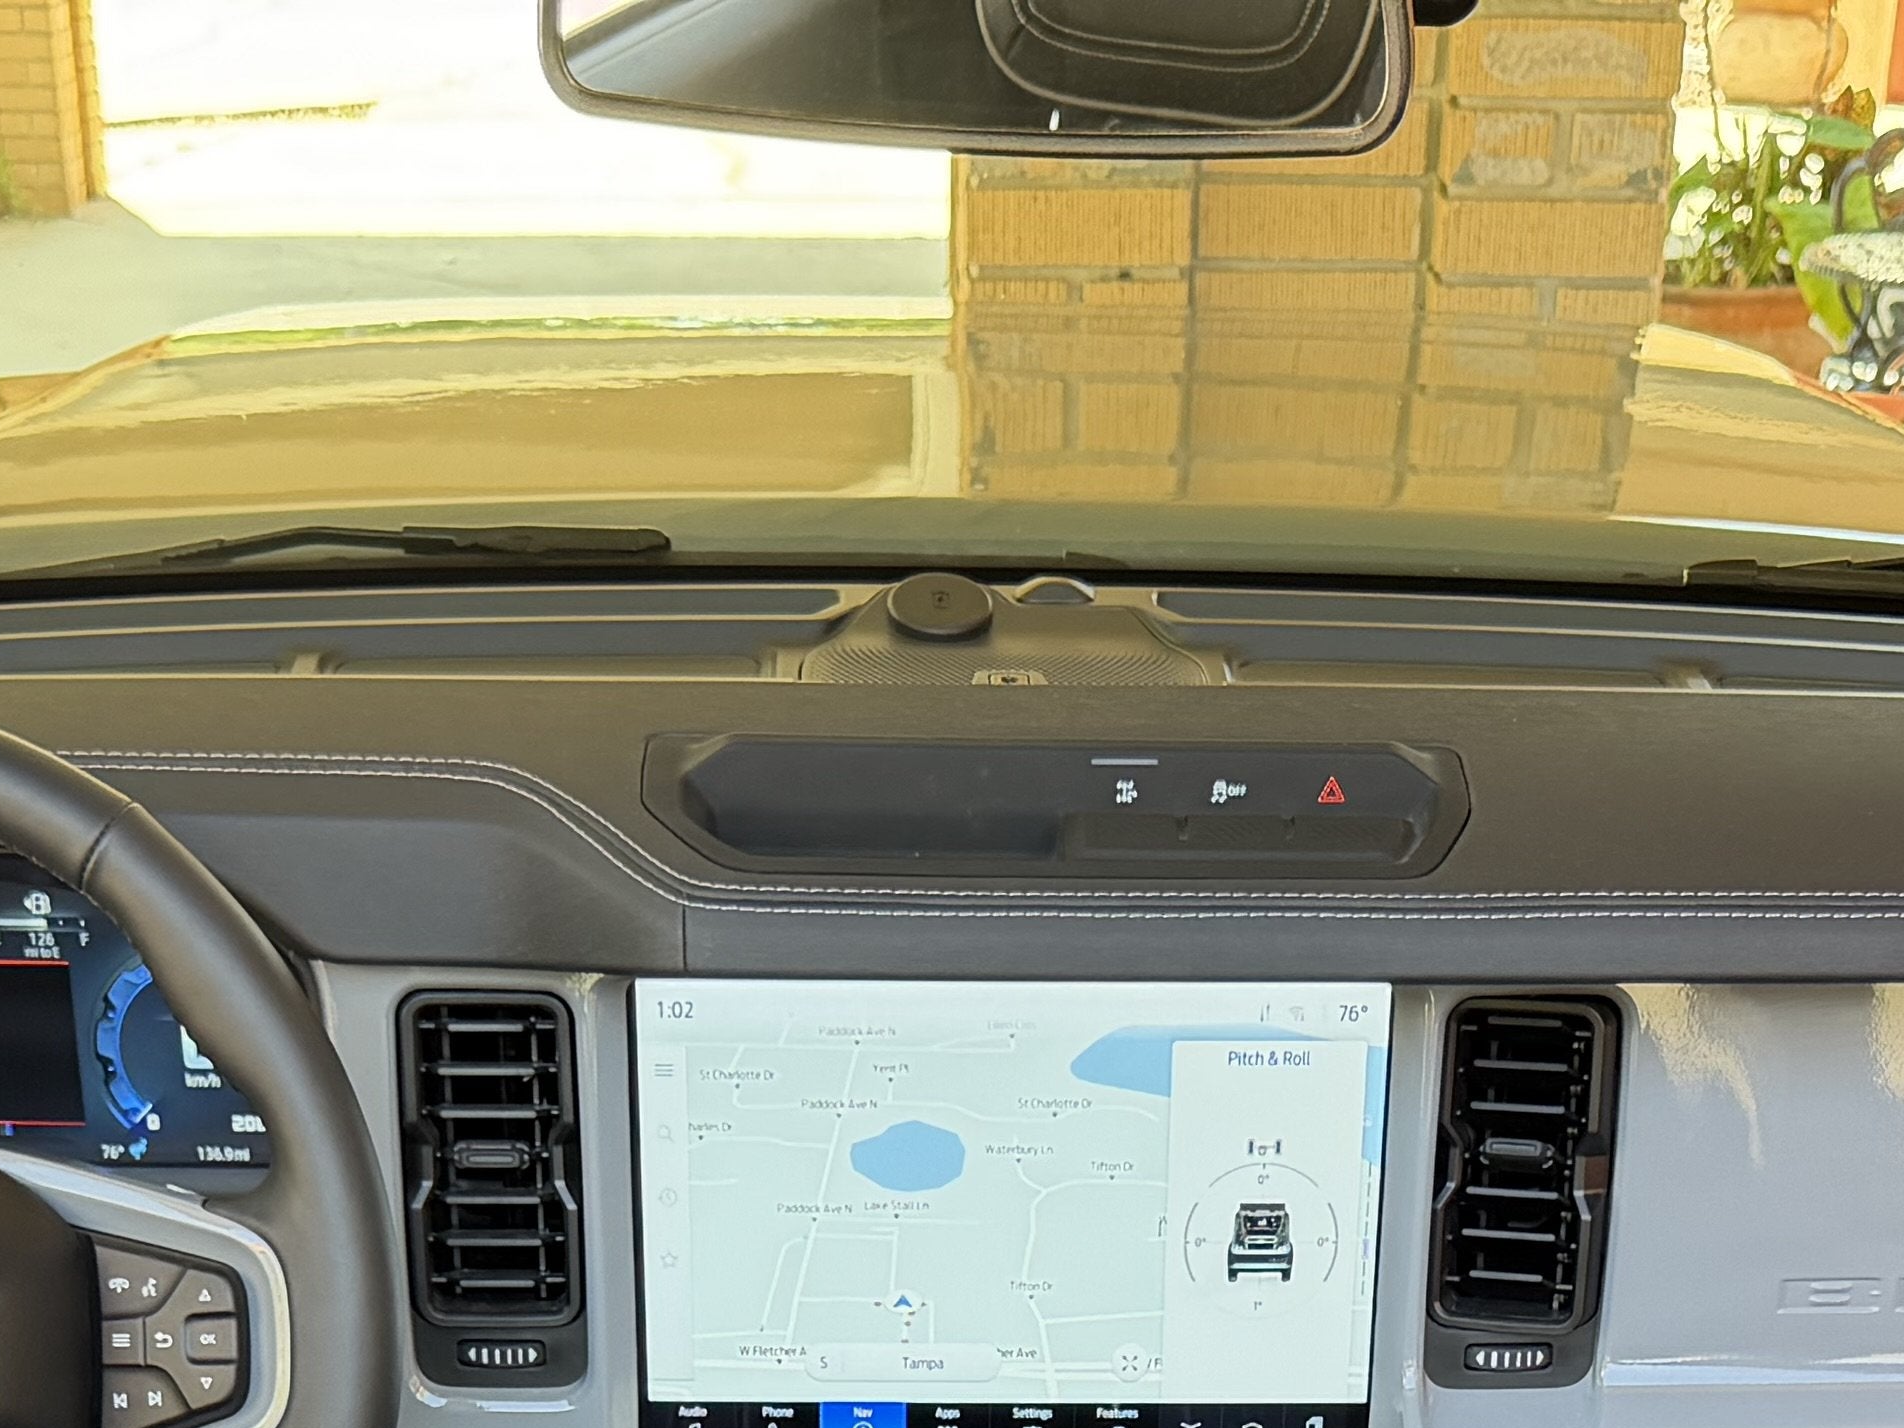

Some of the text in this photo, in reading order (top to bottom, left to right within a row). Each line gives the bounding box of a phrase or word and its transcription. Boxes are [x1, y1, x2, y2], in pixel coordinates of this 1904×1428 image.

[79, 932, 90, 947] F
[657, 1001, 694, 1018] 1:02
[1339, 1004, 1369, 1022] 76°
[1227, 1051, 1311, 1067] Pitch & Roll
[184, 1071, 221, 1088] km/h
[699, 1069, 775, 1081] St Charlotte Dr
[801, 1098, 878, 1109] Paddock Ave N
[1018, 1098, 1092, 1109] St Charlotte Dr
[147, 1114, 162, 1131] 0
[985, 1144, 1038, 1156] Waterbury
[1091, 1161, 1134, 1172] Tifton Dr
[777, 1203, 853, 1214] Paddock Ave N
[1010, 1281, 1053, 1292] Tifton Dr
[199, 1333, 217, 1345] OK
[739, 1346, 751, 1356] W
[752, 1346, 797, 1357] Fletcher
[1016, 1347, 1038, 1359] Ave
[820, 1357, 828, 1369] S
[902, 1357, 944, 1371] Tampa
[678, 1406, 707, 1418] Audio
[762, 1406, 794, 1418] Phone
[853, 1407, 873, 1418] Nav
[935, 1407, 960, 1420] Apps
[1012, 1407, 1053, 1421] Settings
[1096, 1407, 1139, 1419] Features
